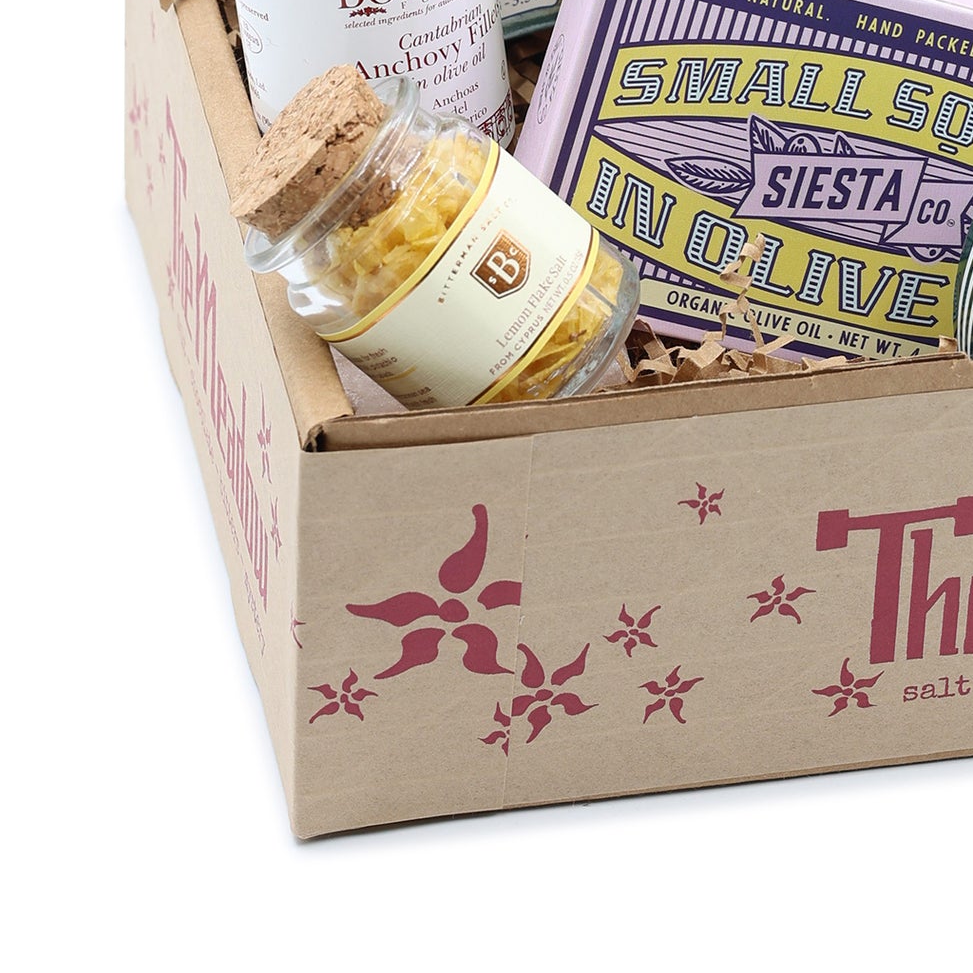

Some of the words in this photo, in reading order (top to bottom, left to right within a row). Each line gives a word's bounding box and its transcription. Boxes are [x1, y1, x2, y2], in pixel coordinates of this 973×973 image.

[345, 18, 376, 28] selected
[378, 8, 424, 25] ingredients
[425, 3, 436, 15] for
[399, 3, 482, 51] Cantabrian
[856, 15, 903, 39] HAND
[355, 38, 462, 80] Anchovy
[434, 59, 469, 85] olive
[473, 43, 486, 67] oil
[613, 57, 871, 119] SMALL
[432, 81, 479, 110] Anchoas
[762, 165, 905, 211] SIESTA
[919, 197, 951, 226] CO.
[437, 236, 479, 304] BITTERMAN
[587, 157, 677, 248] IN
[686, 210, 952, 328] OLIVE
[496, 308, 533, 348] Lemon
[528, 276, 553, 309] Flake
[549, 253, 568, 281] Salt
[667, 290, 737, 319] ORGAN
[743, 308, 789, 332] OLIVE
[796, 320, 821, 340] OIL
[839, 330, 870, 350] NET
[166, 94, 195, 342] The
[193, 212, 268, 614] Meadow
[489, 350, 514, 376] FROM
[514, 314, 544, 351] CYPRUS
[902, 674, 972, 704] salt
